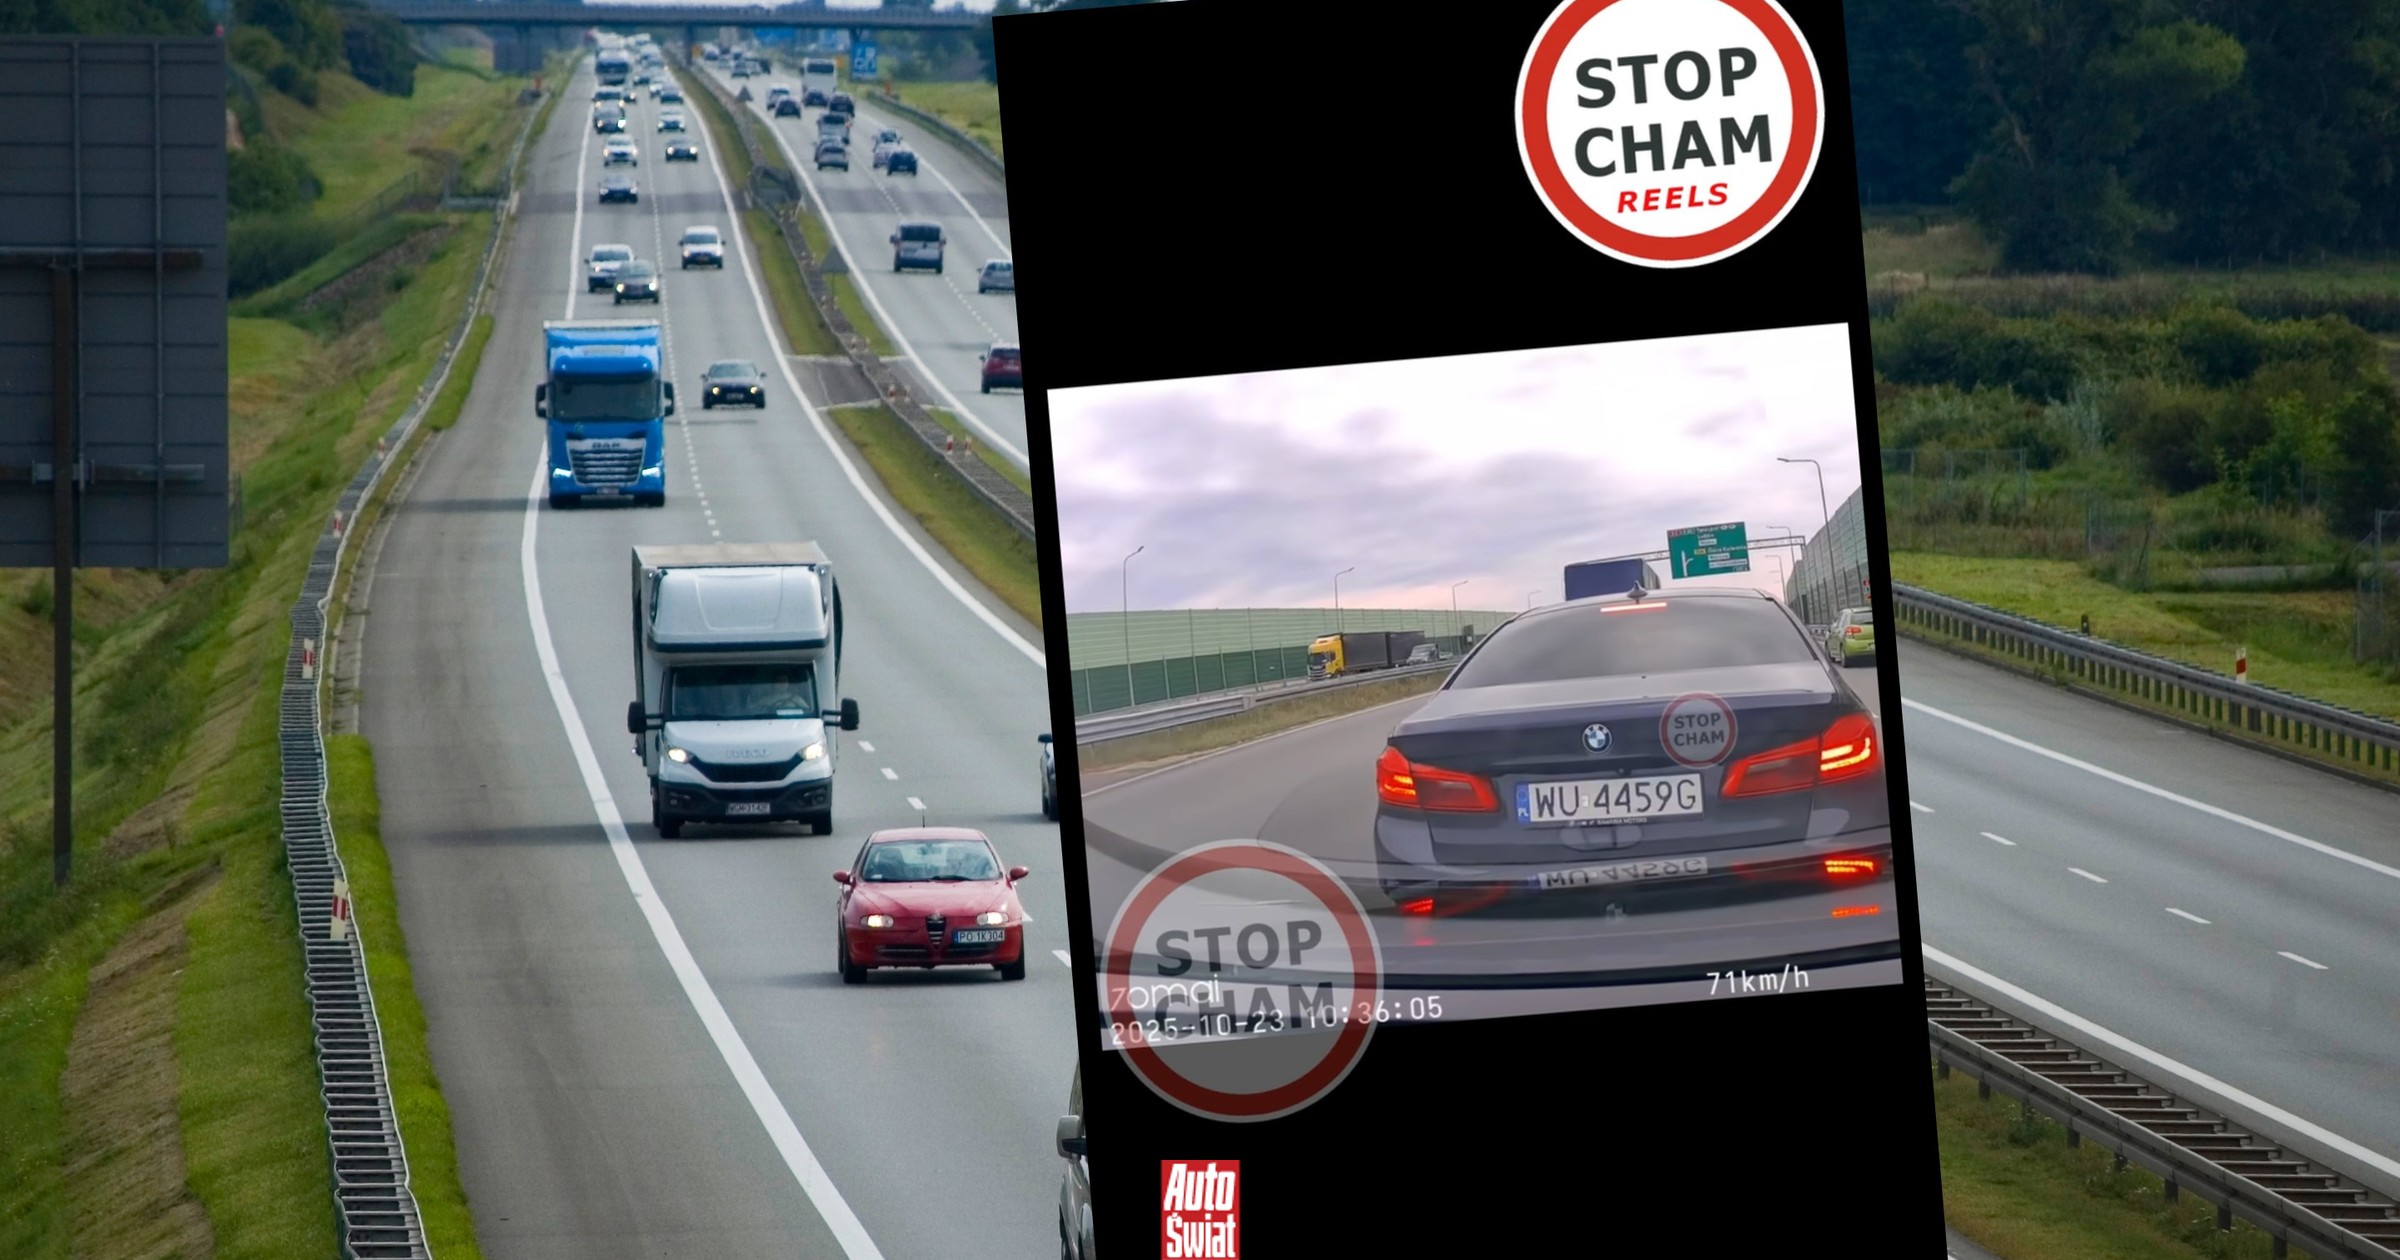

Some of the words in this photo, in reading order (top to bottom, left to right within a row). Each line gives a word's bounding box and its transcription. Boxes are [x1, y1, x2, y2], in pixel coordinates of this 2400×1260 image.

[1535, 785, 1580, 818] WU
[1593, 779, 1697, 814] 4459G
[959, 932, 973, 942] PO
